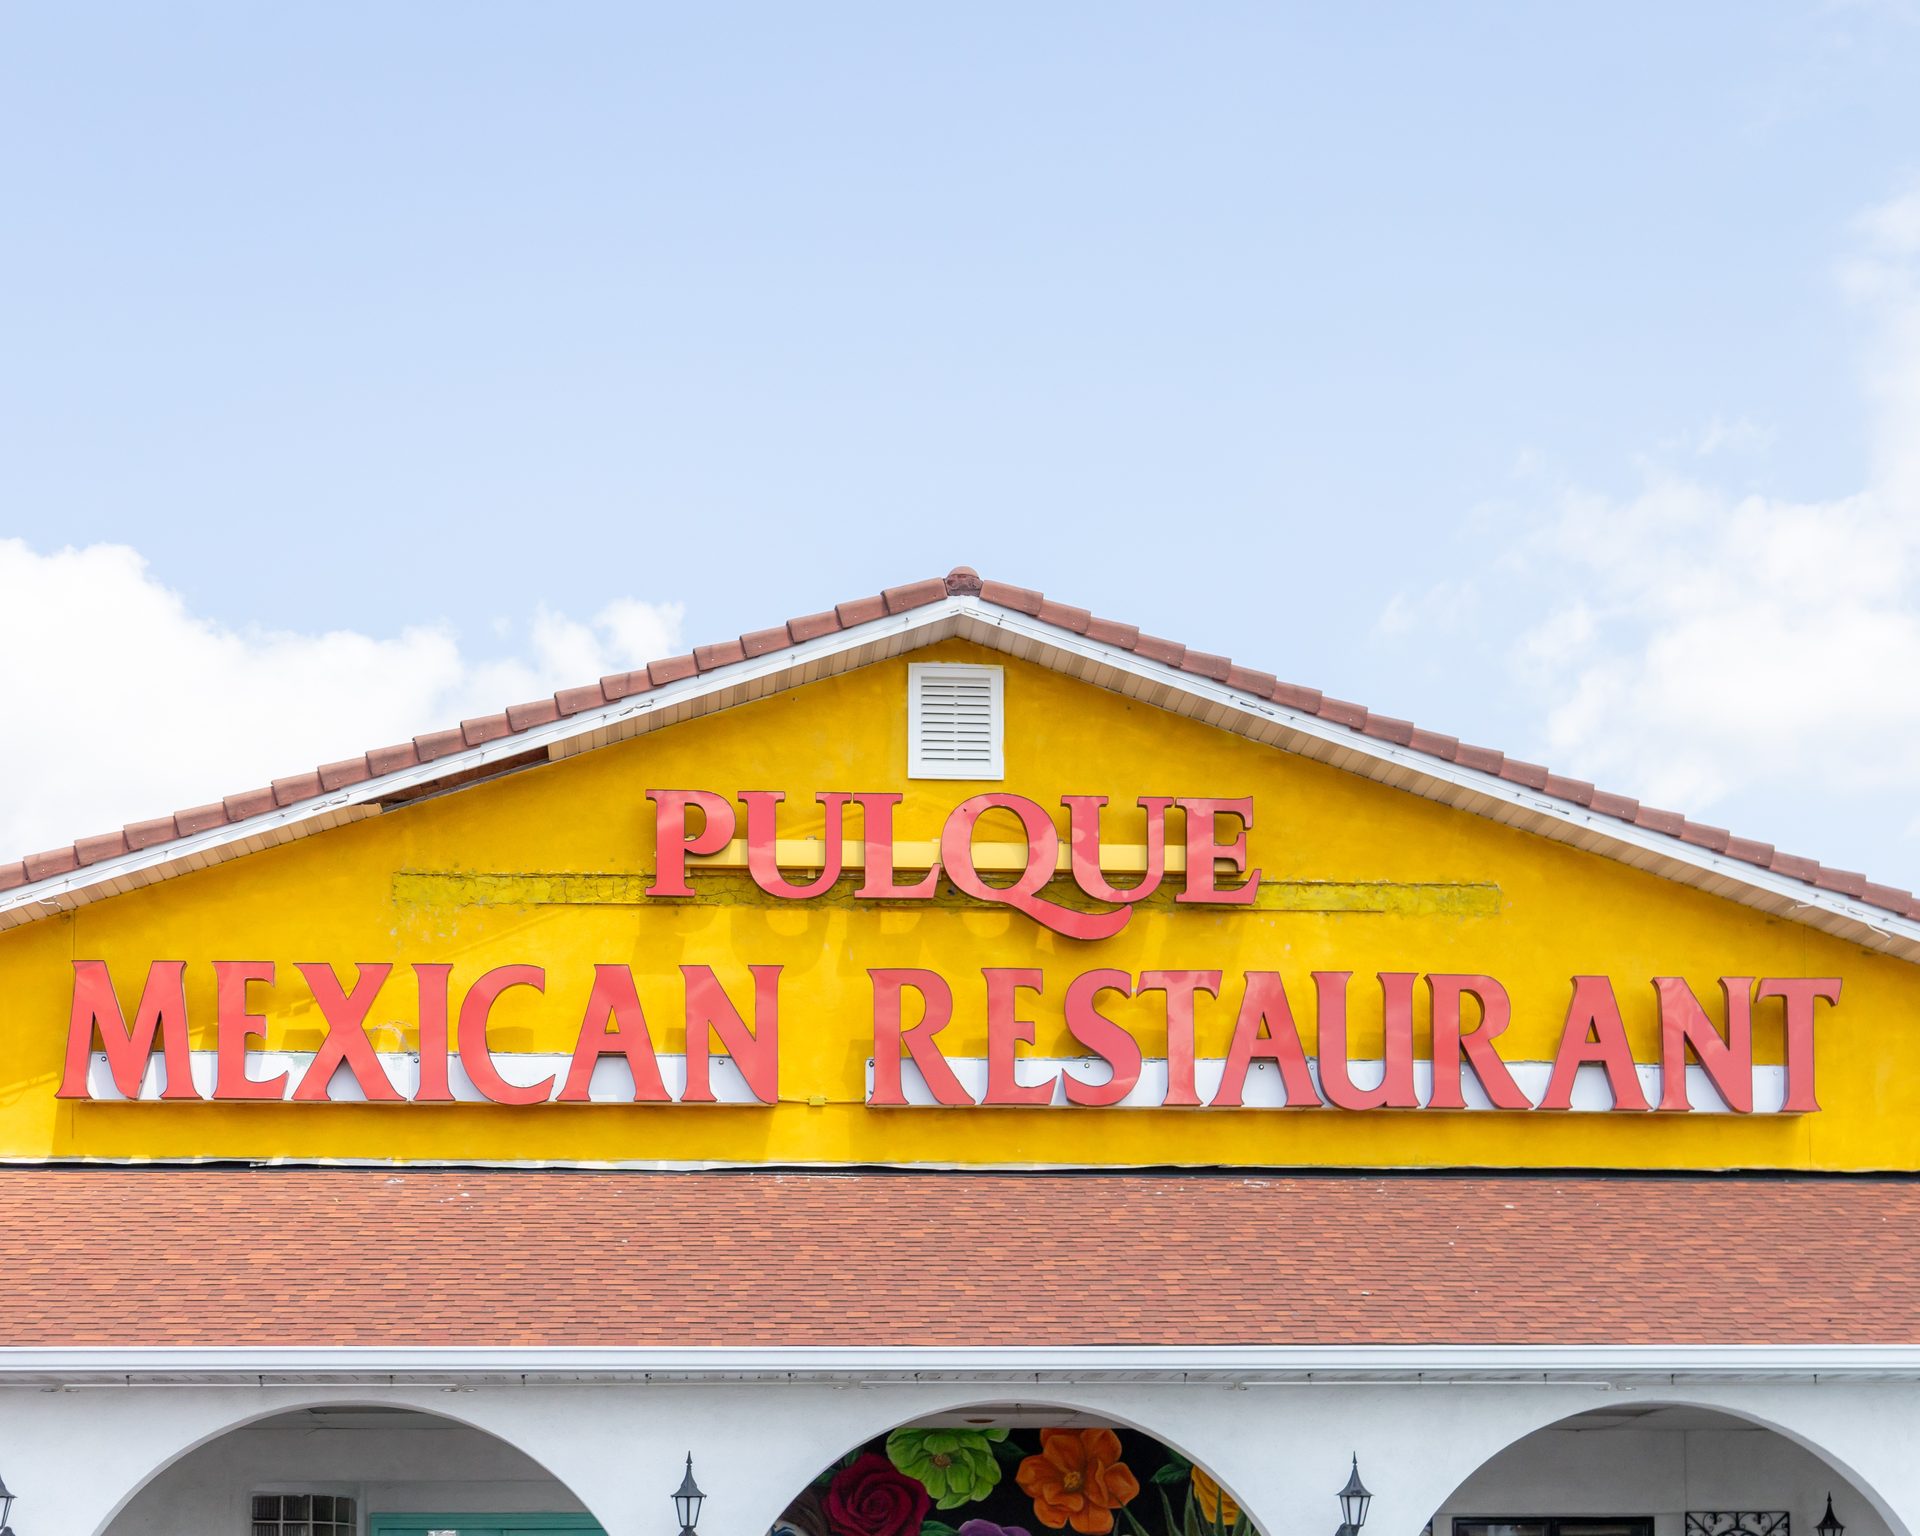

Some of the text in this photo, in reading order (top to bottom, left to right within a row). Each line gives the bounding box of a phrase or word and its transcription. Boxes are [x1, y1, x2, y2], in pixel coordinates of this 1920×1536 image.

[646, 789, 1261, 941] PULQUE
[56, 960, 1841, 1113] MEXICAN RESTAURANT
